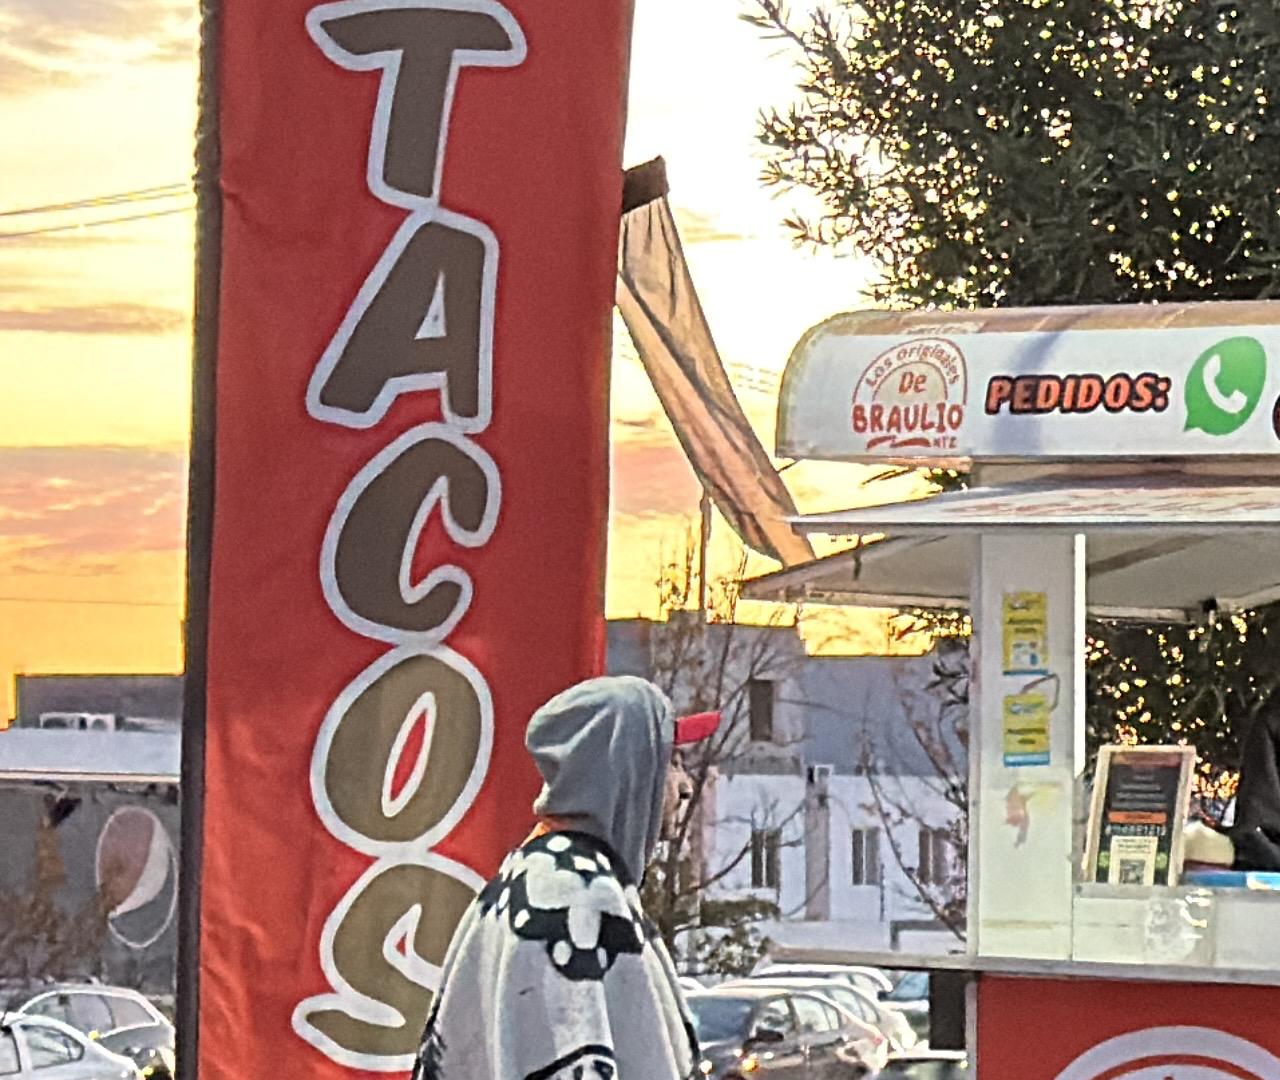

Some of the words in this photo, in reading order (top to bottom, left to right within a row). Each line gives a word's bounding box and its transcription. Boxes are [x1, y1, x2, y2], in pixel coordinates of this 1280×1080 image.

[899, 371, 927, 394] De
[985, 373, 1172, 414] PEDIDOS:
[852, 403, 963, 433] BRAULIO
[291, 0, 527, 1071] TACOS
